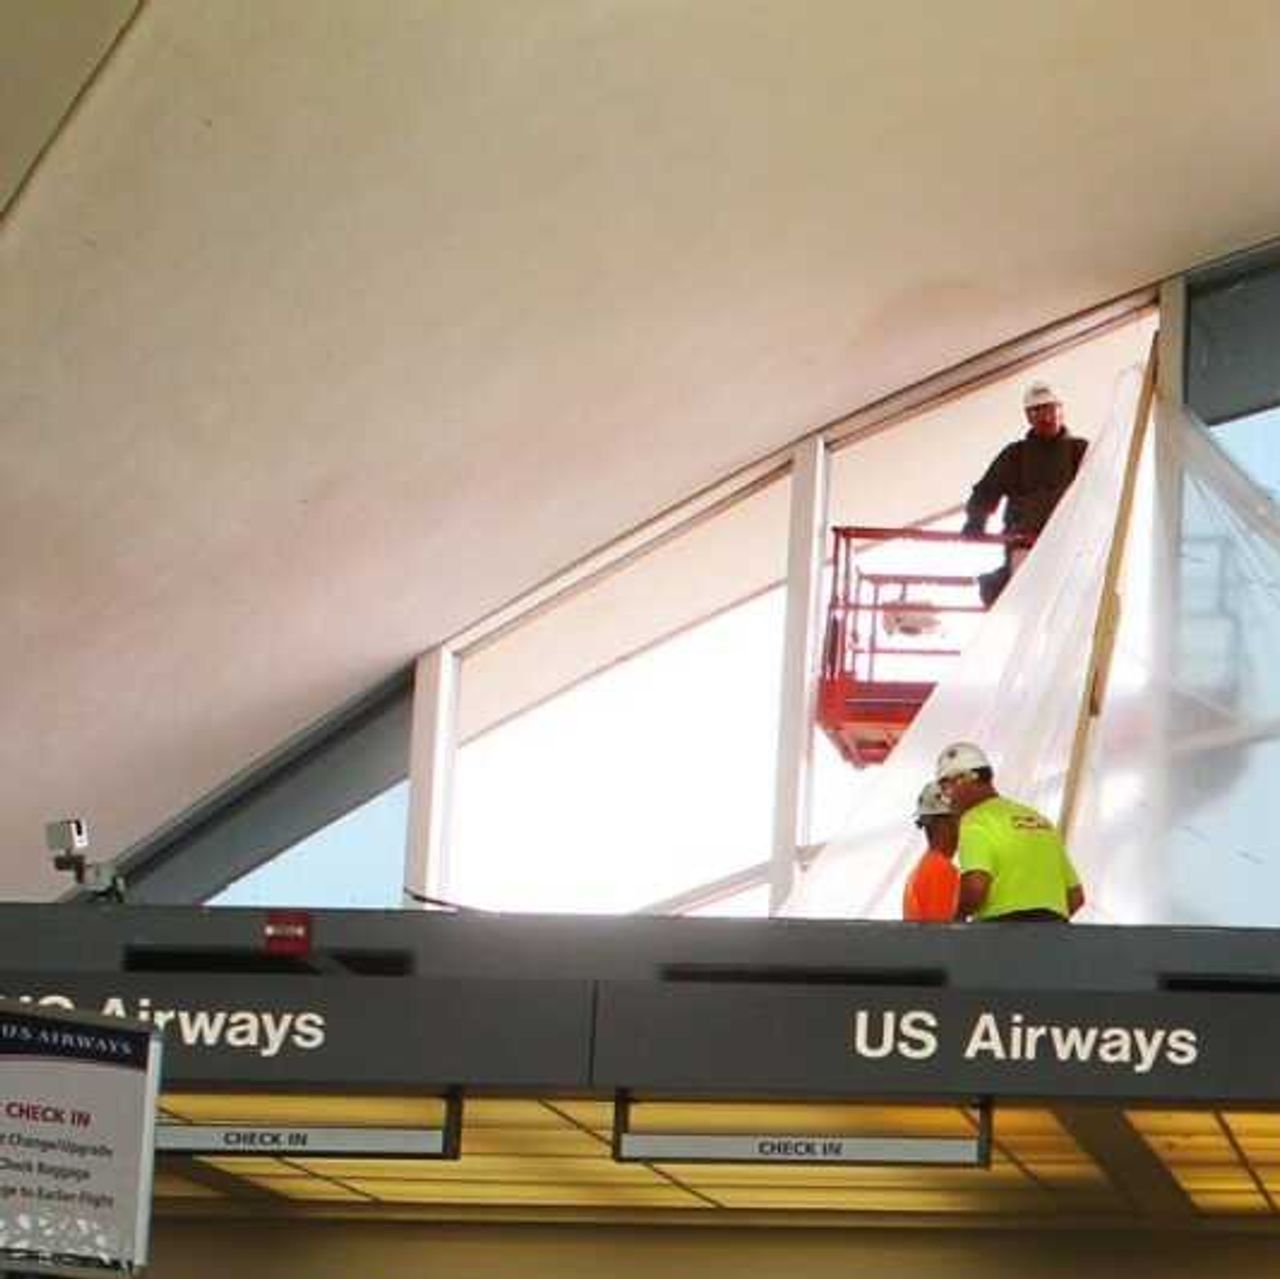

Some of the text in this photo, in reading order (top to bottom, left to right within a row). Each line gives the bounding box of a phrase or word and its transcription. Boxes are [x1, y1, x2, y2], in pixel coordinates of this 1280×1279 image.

[39, 1029, 132, 1055] AIRWAYS
[855, 1010, 1198, 1073] US Airways
[5, 1101, 92, 1129] CHECK IN
[223, 1132, 308, 1147] CHECK IN
[758, 1141, 844, 1156] CHECK IN
